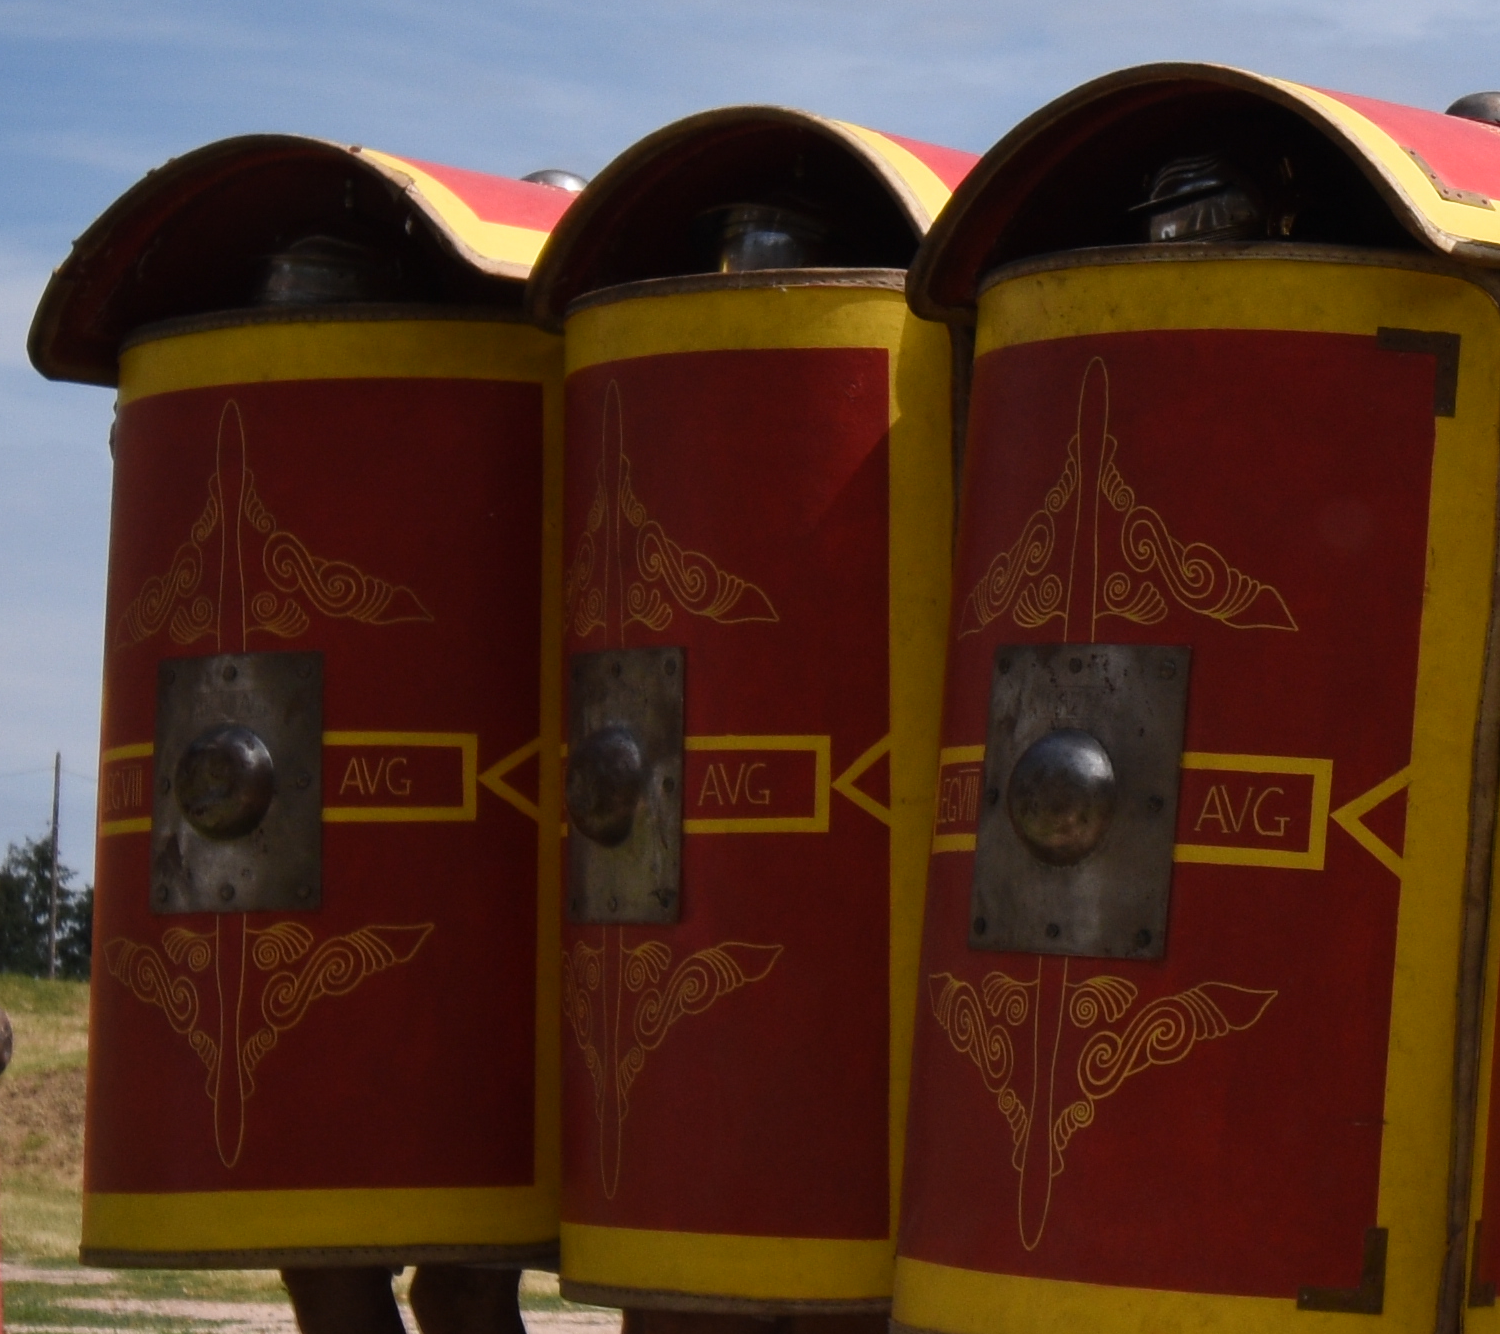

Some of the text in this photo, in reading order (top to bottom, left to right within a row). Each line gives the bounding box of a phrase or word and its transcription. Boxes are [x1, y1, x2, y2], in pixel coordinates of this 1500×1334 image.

[338, 756, 412, 796] AVG
[697, 762, 771, 806] AVG
[1193, 784, 1291, 837] AVG
